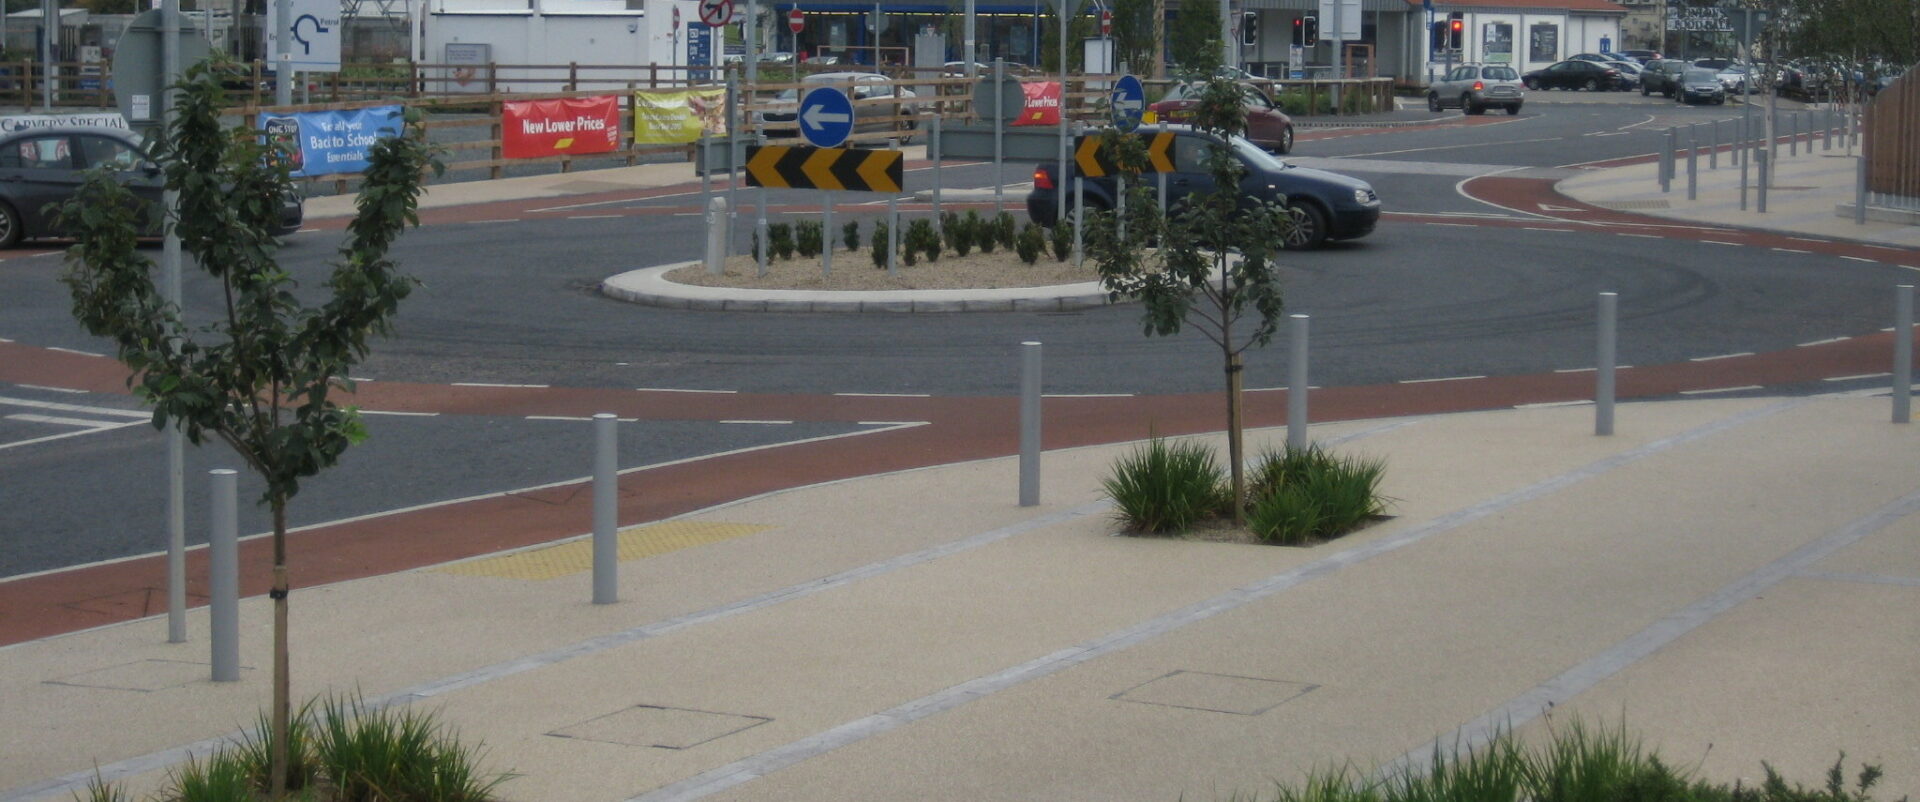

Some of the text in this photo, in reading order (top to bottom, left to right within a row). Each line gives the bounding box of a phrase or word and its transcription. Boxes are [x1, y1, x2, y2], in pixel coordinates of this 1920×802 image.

[320, 17, 339, 25] Petrol
[70, 116, 126, 129] SPECIAL
[334, 120, 345, 131] all
[346, 121, 362, 132] your
[522, 115, 605, 134] New Lower Prices
[332, 136, 344, 148] to
